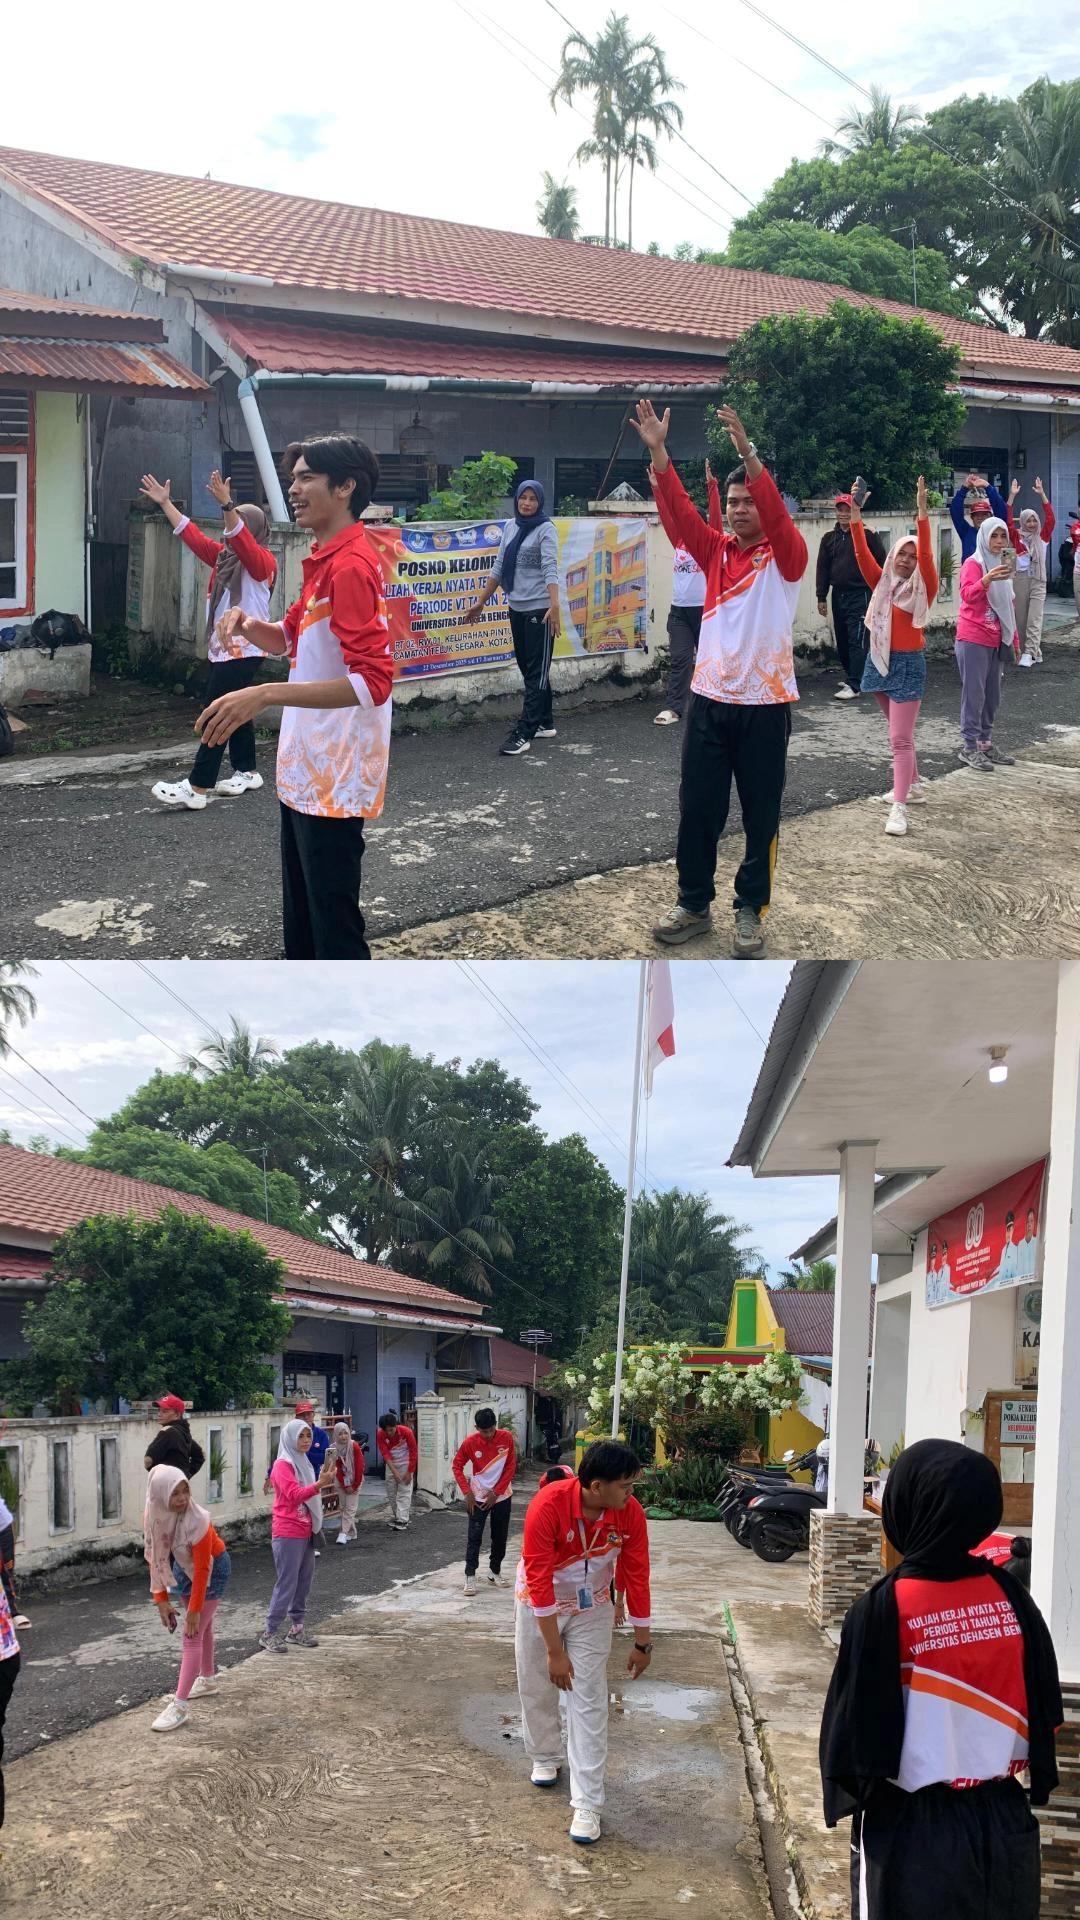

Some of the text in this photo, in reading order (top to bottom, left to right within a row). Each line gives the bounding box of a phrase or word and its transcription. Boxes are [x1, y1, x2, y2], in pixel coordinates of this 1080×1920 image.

[398, 560, 446, 577] POSKO
[449, 555, 498, 574] KELOMP
[384, 583, 410, 598] LIAH
[412, 581, 443, 596] KERJA
[445, 577, 476, 593] NYATA
[410, 598, 453, 615] PERIODE
[456, 597, 466, 610] VI
[411, 617, 457, 632] UNIVERSITAS
[445, 630, 489, 643] KELURAHAN
[489, 637, 509, 648] KOTA
[907, 1612, 940, 1631] KULIAH
[940, 1607, 967, 1622] KERJA
[967, 1603, 995, 1617] NYATA
[923, 1622, 960, 1639] PERIODE
[960, 1619, 970, 1631] VI
[970, 1614, 1001, 1629] TAHUN
[960, 1628, 1003, 1645] DEHASEN
[1003, 1623, 1022, 1637] BEN
